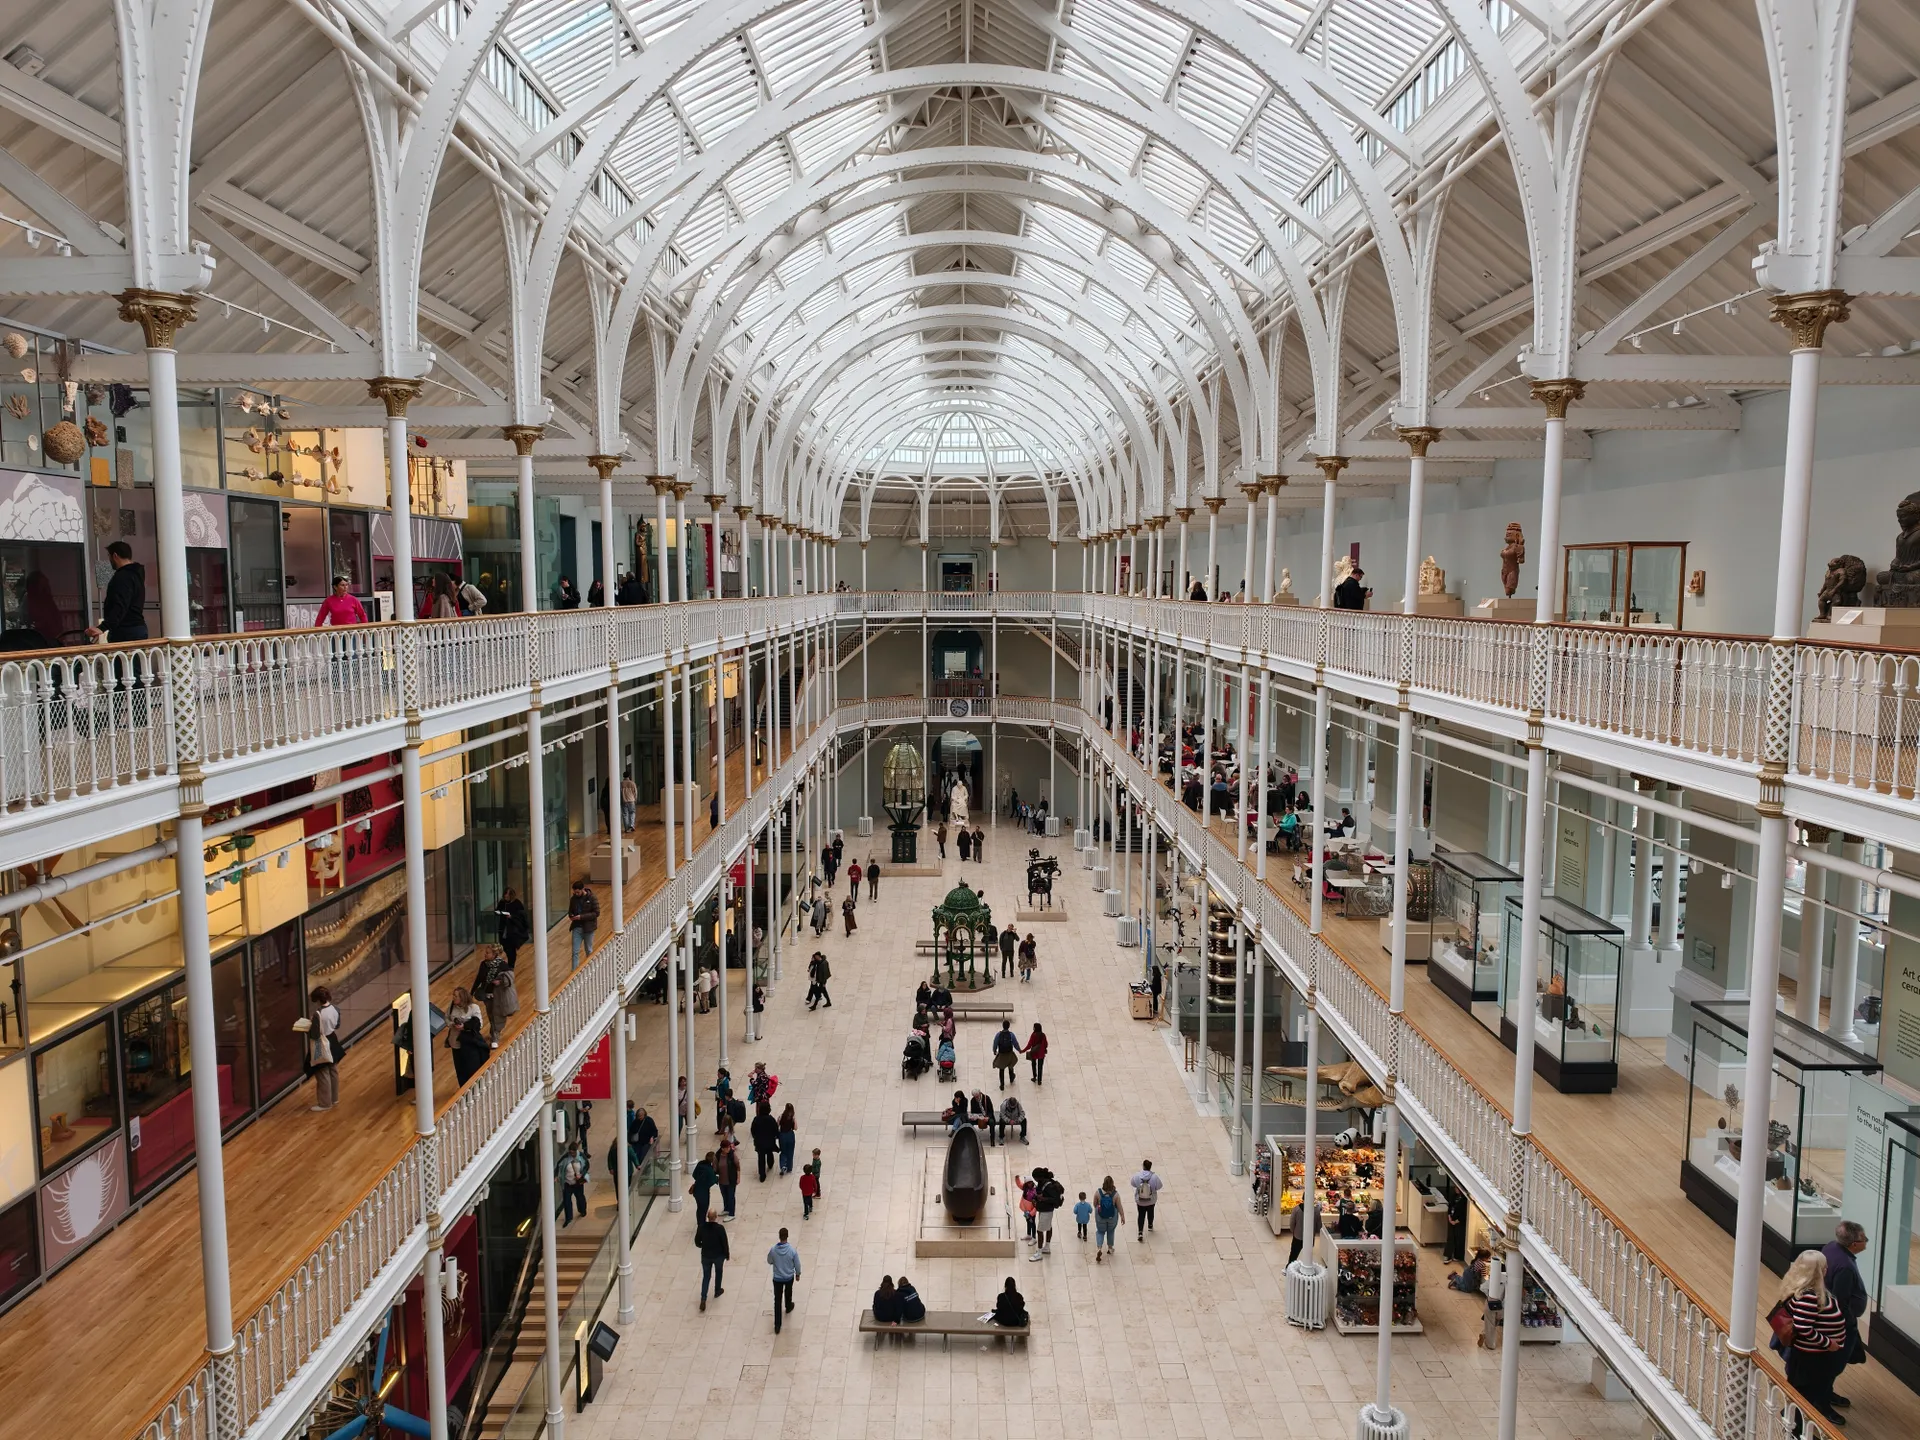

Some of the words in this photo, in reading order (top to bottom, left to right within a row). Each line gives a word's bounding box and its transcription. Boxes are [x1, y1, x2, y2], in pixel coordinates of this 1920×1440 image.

[1902, 967, 1915, 980] Art
[1857, 1105, 1870, 1119] From
[1857, 1115, 1863, 1123] to
[1864, 1119, 1872, 1129] the
[1874, 1124, 1882, 1134] lab
